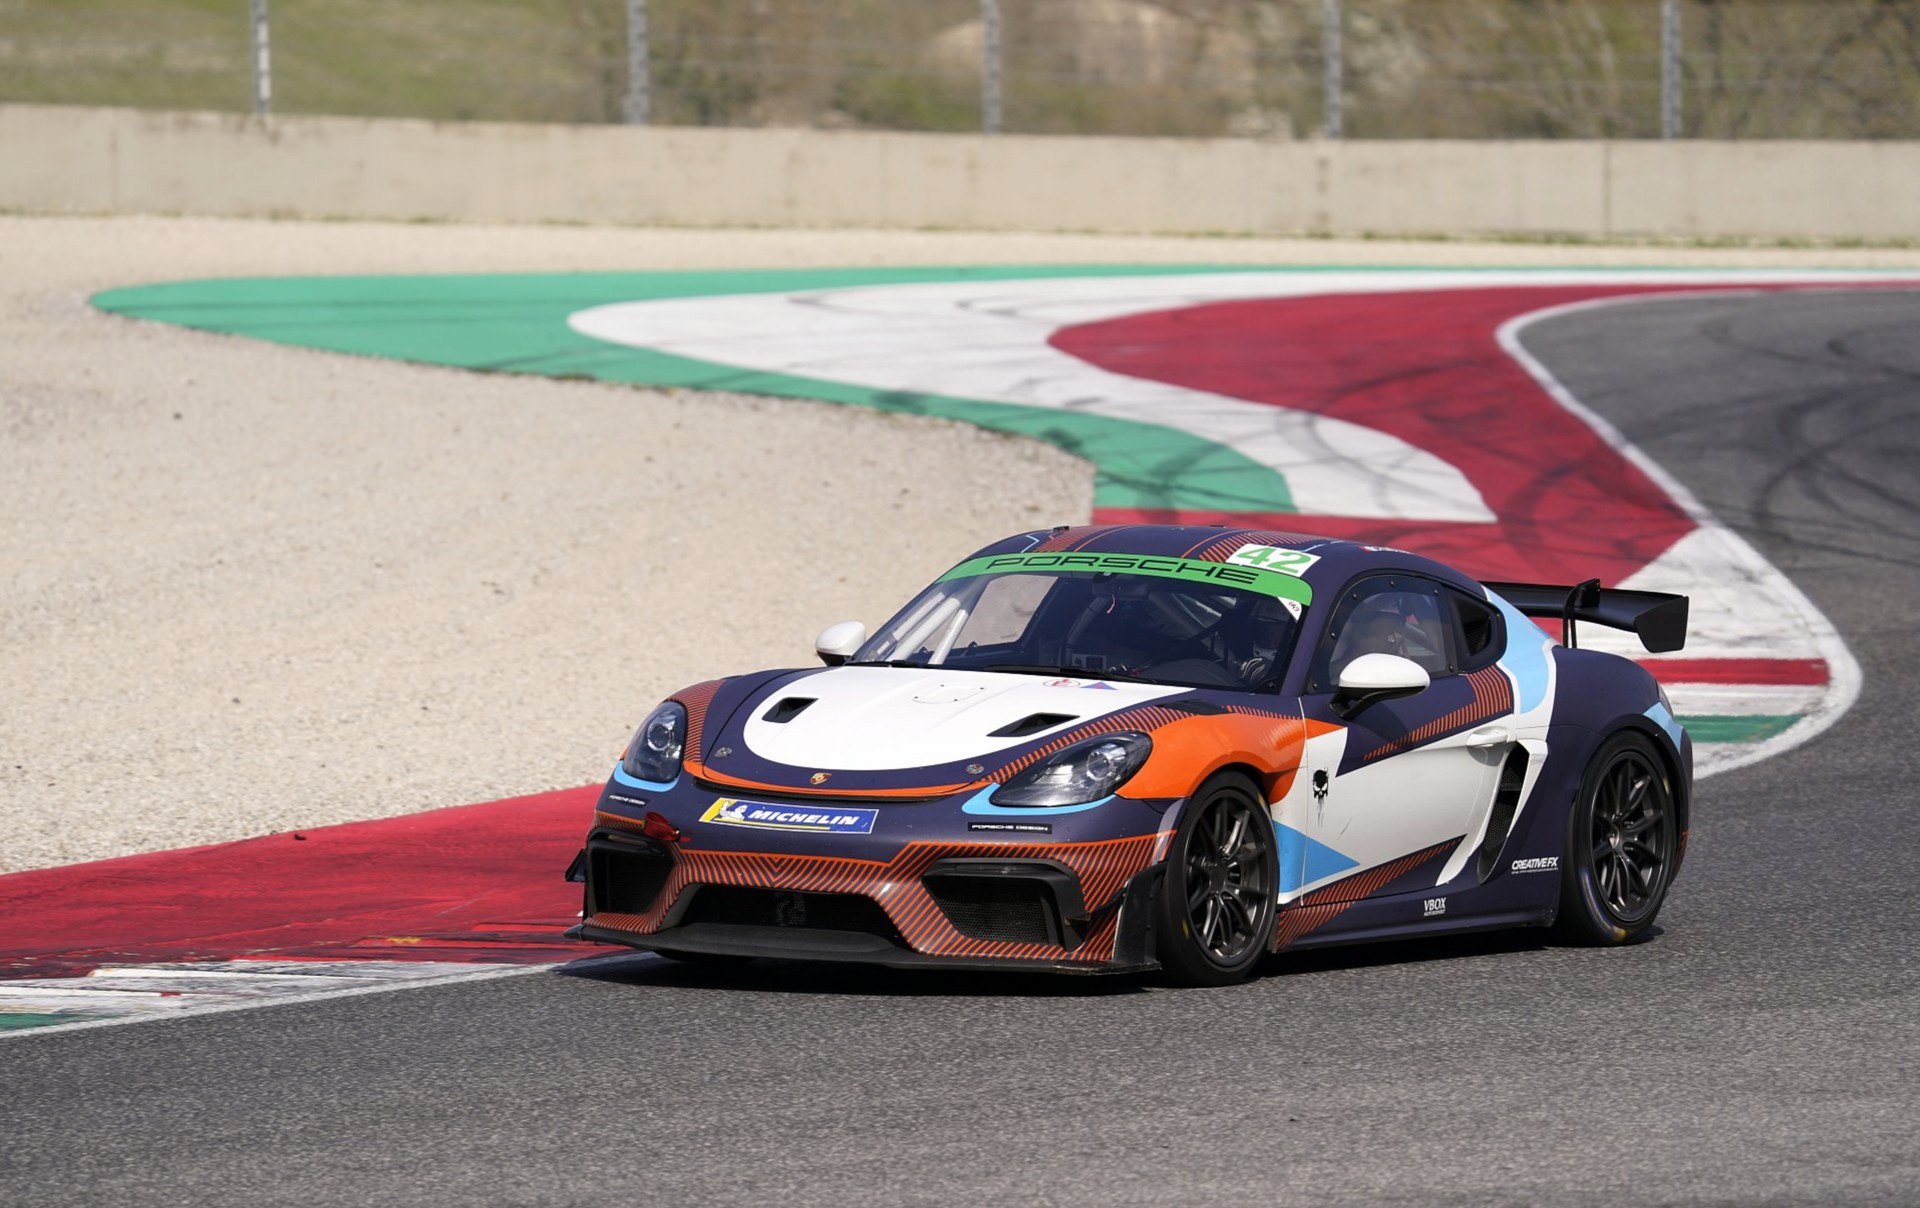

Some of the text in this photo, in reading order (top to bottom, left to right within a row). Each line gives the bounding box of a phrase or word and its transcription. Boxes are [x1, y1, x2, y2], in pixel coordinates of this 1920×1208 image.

[986, 555, 1260, 585] PORSCHE
[1236, 547, 1312, 574] 42
[748, 809, 860, 826] MICHELIN
[1423, 897, 1447, 912] VBOX
